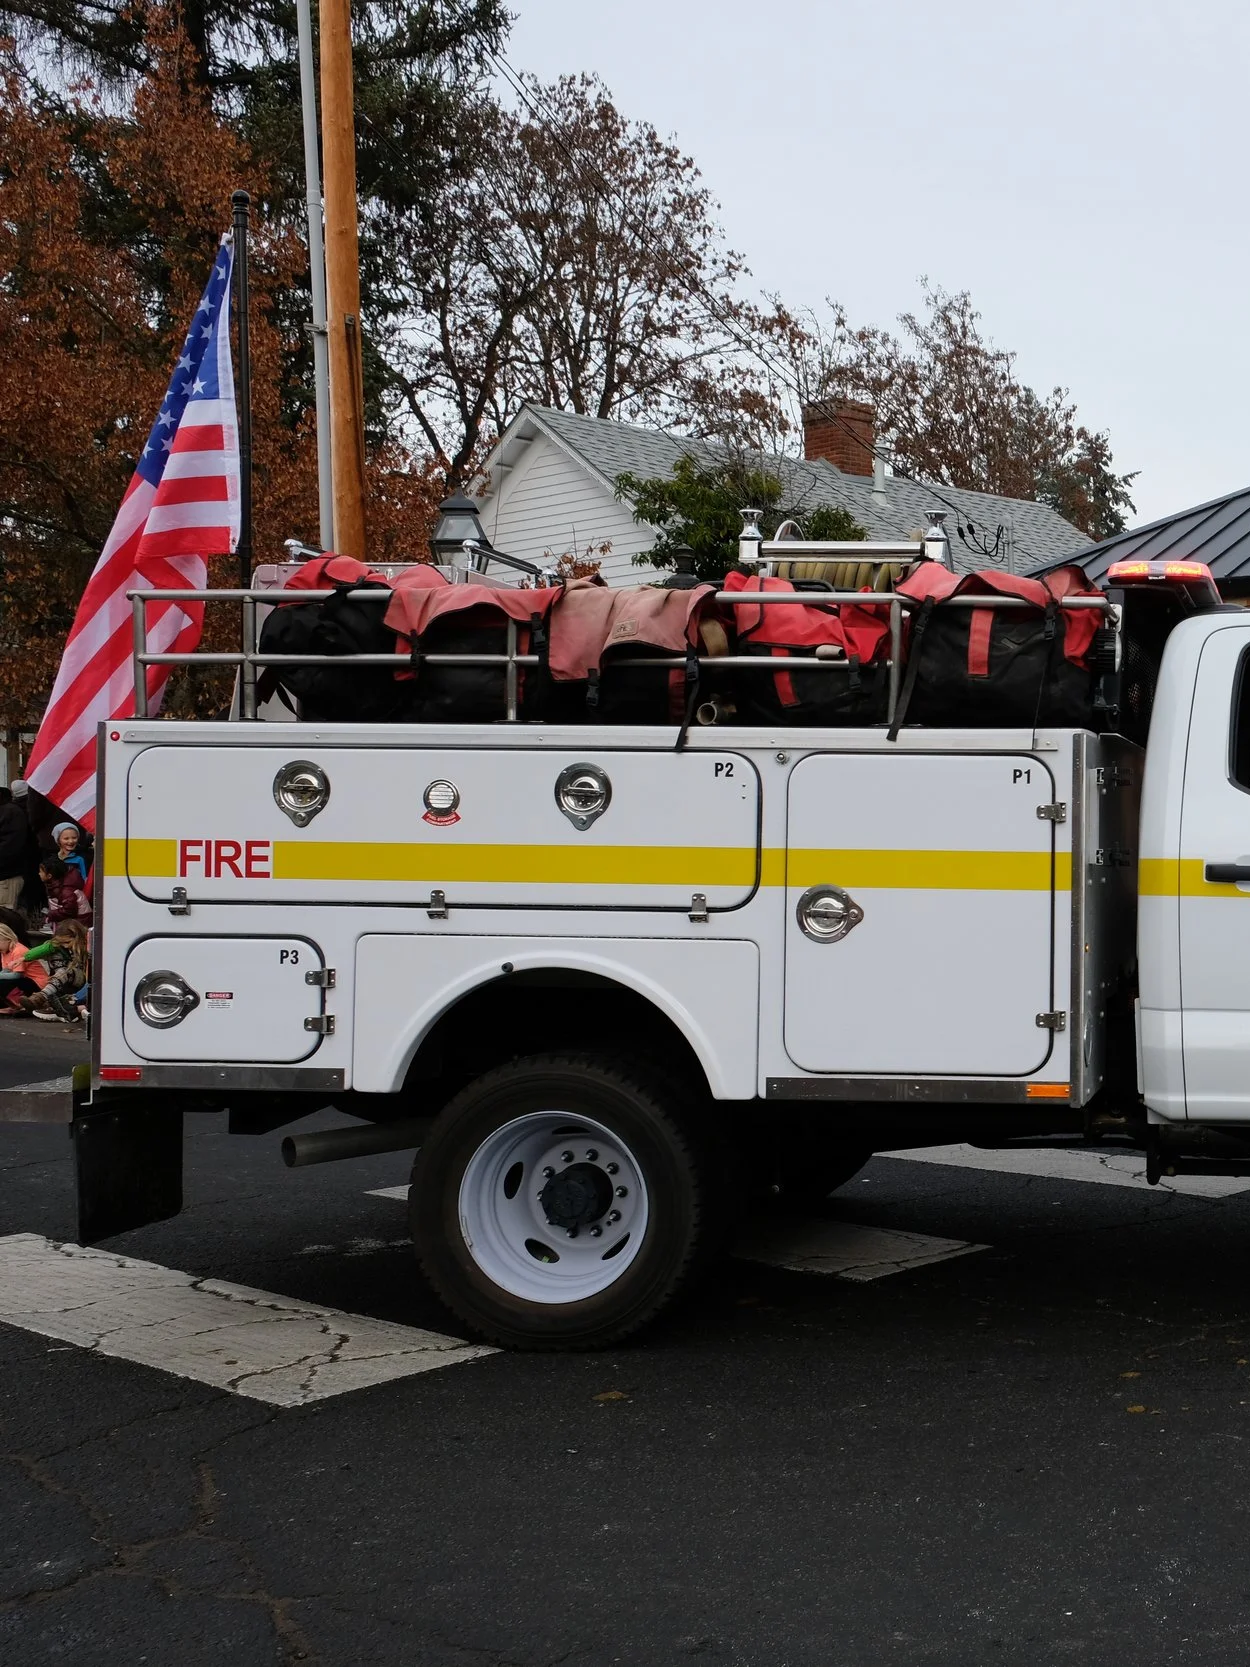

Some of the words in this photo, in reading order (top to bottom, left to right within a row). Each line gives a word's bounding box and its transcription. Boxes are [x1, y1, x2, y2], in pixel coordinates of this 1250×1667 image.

[714, 762, 734, 778] P2
[1012, 768, 1031, 785] P1
[180, 839, 272, 879] FIRE
[279, 949, 299, 964] P3
